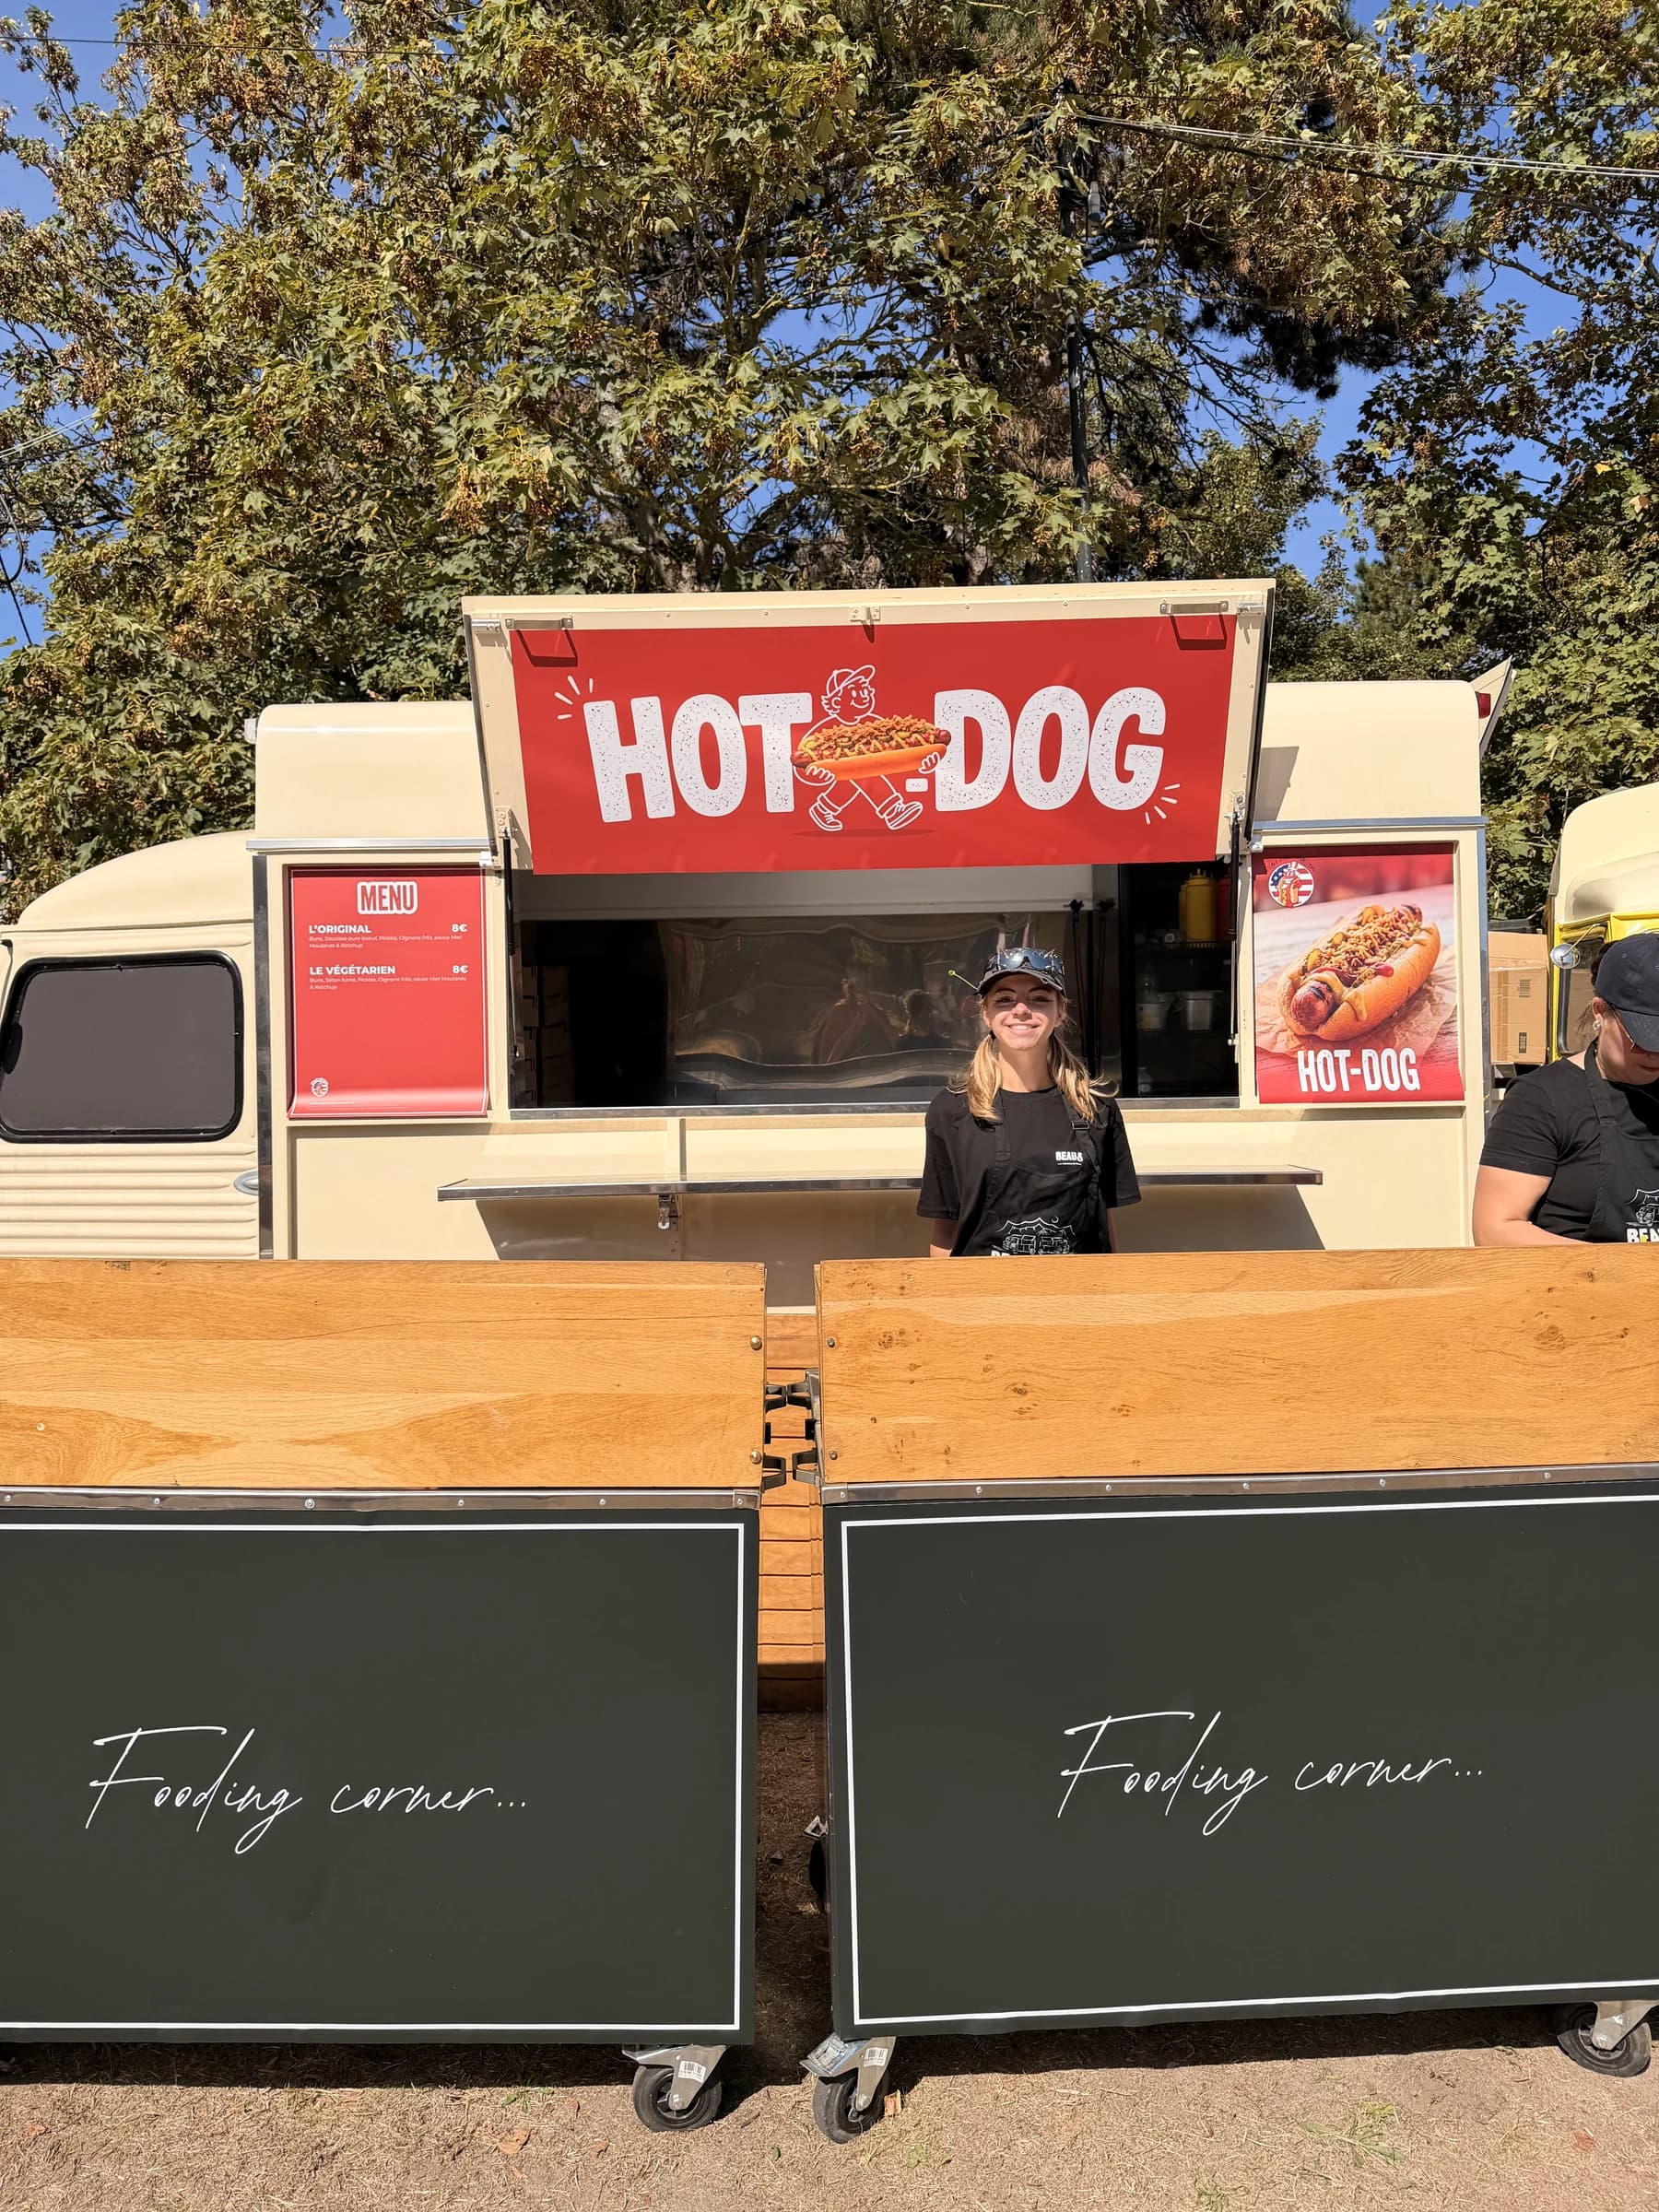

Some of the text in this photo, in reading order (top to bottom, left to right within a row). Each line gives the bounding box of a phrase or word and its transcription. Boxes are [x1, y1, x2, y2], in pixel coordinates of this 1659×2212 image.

[583, 692, 812, 823] HOT
[360, 884, 415, 912] MENU
[309, 924, 468, 934] L'ORIGINAL 8€
[310, 963, 469, 975] LE VÉGÉTARIEN 8€
[1298, 1048, 1420, 1092] HOT-DOG
[85, 1725, 303, 1854] Fooding
[1057, 1712, 1269, 1836] Fooding
